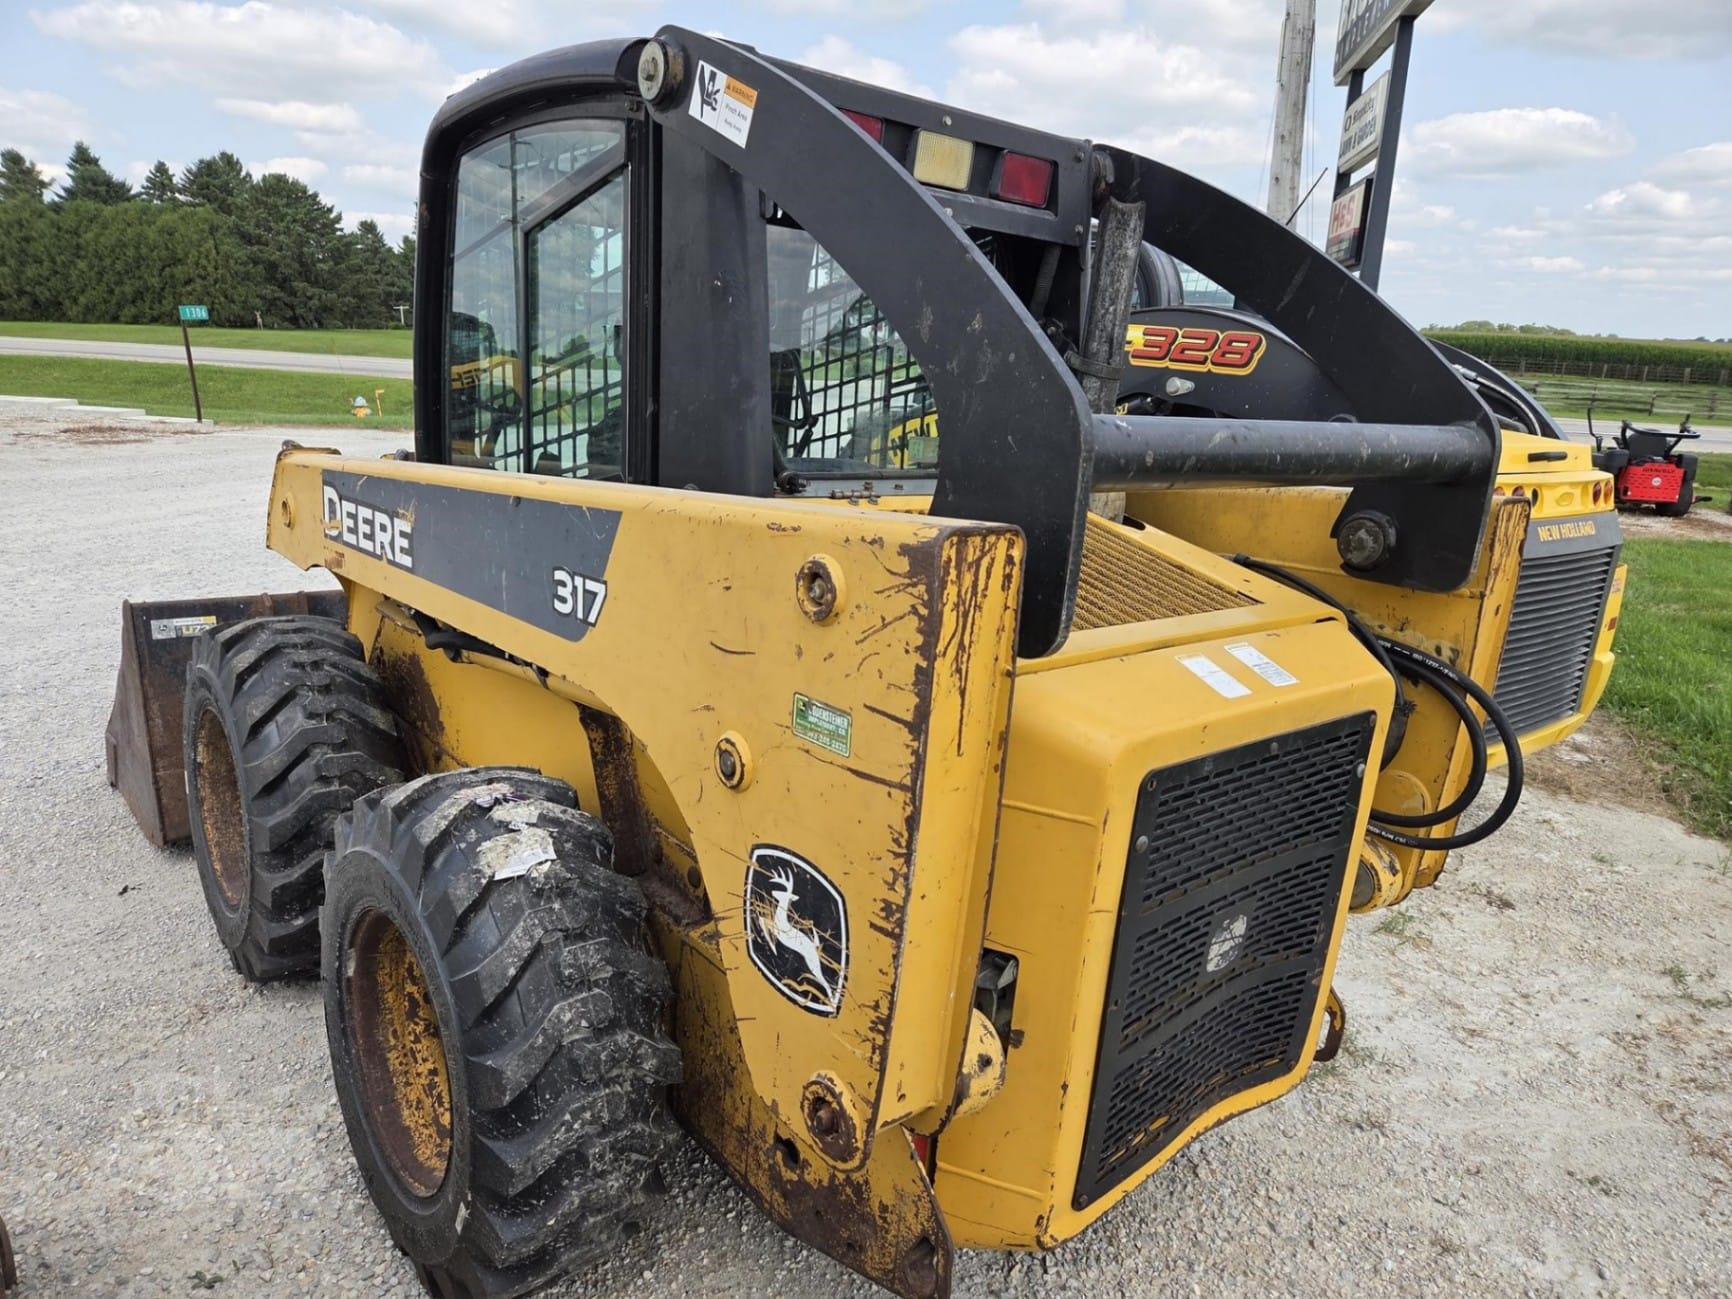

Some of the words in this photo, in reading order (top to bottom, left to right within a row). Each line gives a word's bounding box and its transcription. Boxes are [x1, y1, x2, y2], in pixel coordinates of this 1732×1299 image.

[1130, 327, 1265, 372] 328
[323, 485, 413, 568] DEERE
[1537, 525, 1560, 542] NEW
[1559, 520, 1596, 539] HOLLAND
[553, 569, 606, 625] 317
